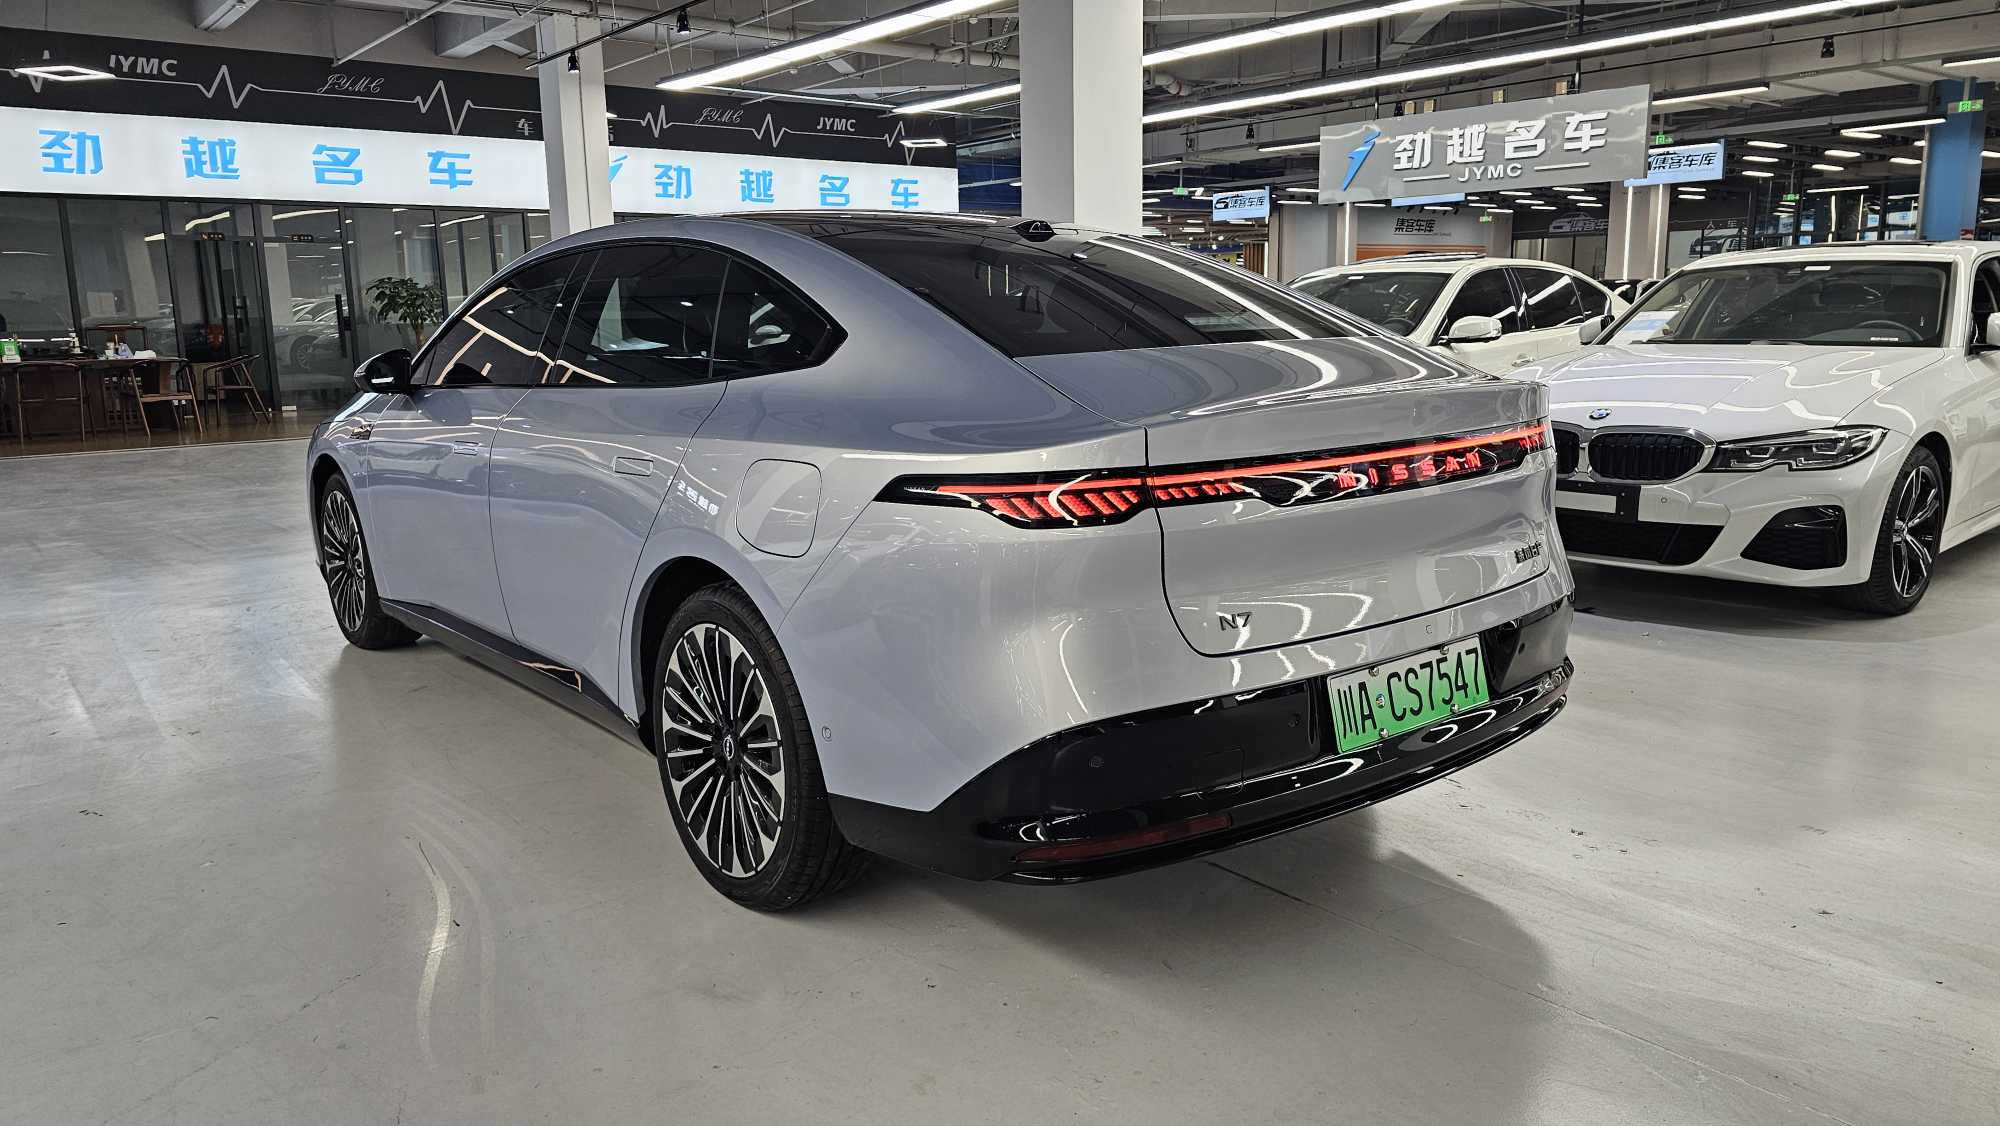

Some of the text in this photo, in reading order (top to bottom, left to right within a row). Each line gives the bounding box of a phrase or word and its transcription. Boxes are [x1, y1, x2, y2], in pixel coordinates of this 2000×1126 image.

[816, 116, 857, 132] JYMC
[1392, 111, 1609, 170] 劲越名车
[38, 129, 474, 189] 劲越名车
[1457, 163, 1523, 183] JYMC
[654, 163, 920, 209] 劲越名车
[1334, 452, 1482, 489] NISSAN
[1219, 611, 1252, 631] N7
